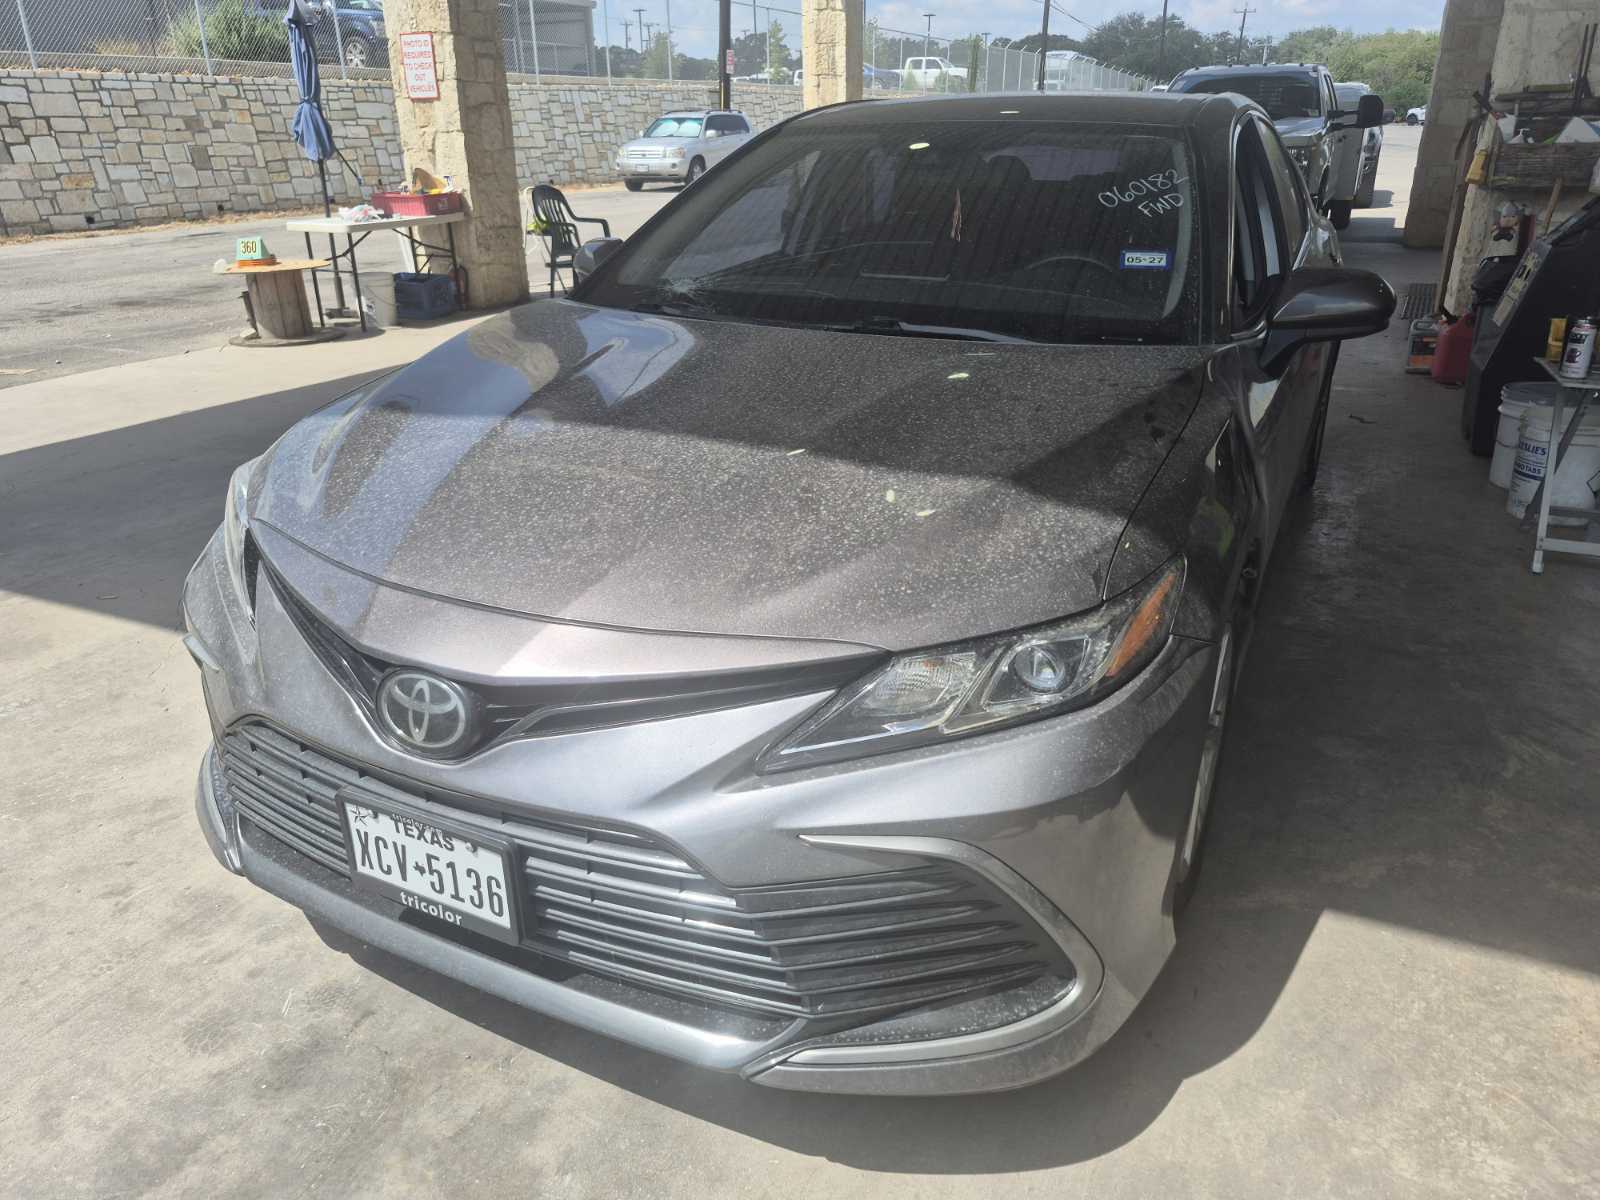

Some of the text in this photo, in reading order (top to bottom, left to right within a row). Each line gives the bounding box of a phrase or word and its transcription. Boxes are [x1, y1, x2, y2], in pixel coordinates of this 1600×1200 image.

[1098, 169, 1189, 208] 060182
[1138, 193, 1185, 218] FWD
[240, 240, 257, 254] 360
[392, 815, 456, 852] TEXAS
[400, 891, 463, 926] tricolor
